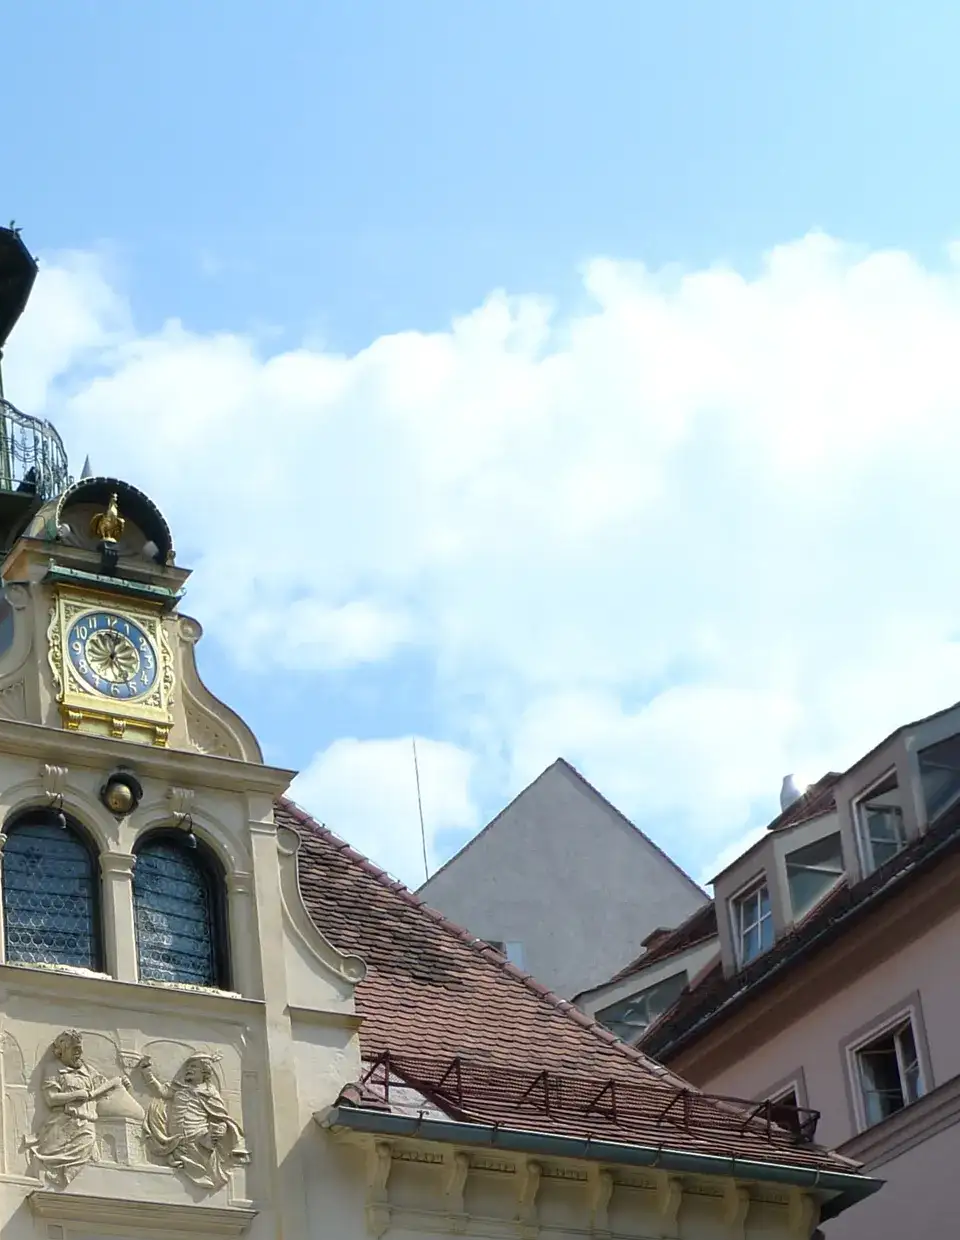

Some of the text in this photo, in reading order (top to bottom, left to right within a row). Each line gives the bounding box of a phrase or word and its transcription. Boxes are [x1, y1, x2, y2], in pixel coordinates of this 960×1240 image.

[89, 617, 97, 629] 11
[107, 616, 118, 629] 12
[75, 626, 87, 640] 10
[125, 624, 131, 635] 1
[73, 642, 81, 655] 9
[140, 638, 148, 651] 2
[79, 661, 88, 674] 8
[145, 656, 153, 670] 3
[92, 674, 100, 686] 7
[141, 671, 149, 685] 4
[111, 683, 120, 695] 6
[130, 682, 137, 695] 5
